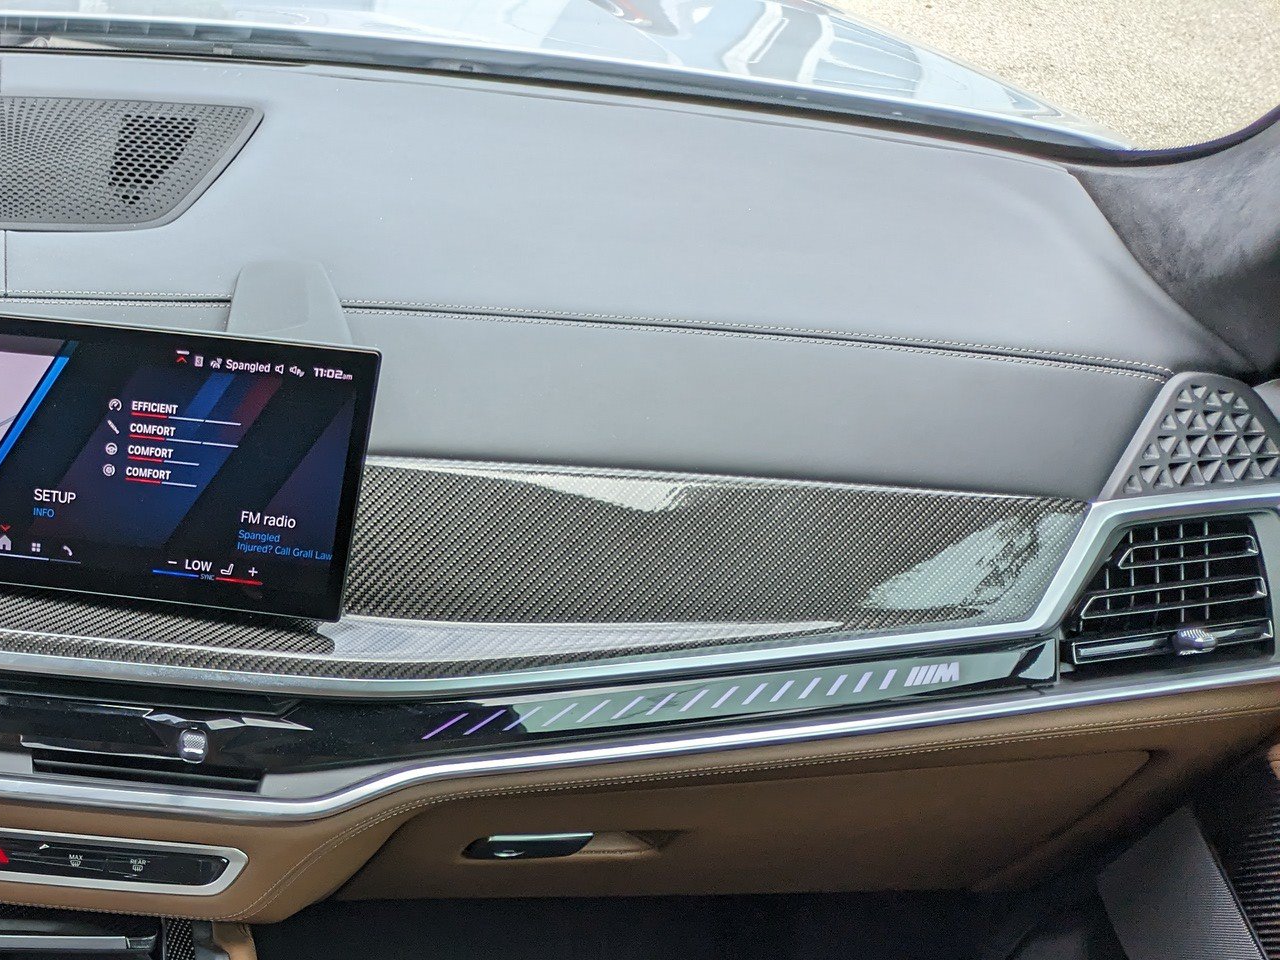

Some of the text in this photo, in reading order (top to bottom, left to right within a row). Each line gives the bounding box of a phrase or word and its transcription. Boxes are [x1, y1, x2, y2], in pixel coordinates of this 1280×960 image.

[225, 358, 271, 374] Spangled
[131, 400, 179, 415] EFFICIENT
[129, 423, 176, 437] COMFORT
[127, 445, 174, 459] COMFORT
[125, 466, 172, 480] COMFORT
[33, 488, 77, 504] SETUP
[33, 507, 55, 518] INFO
[240, 510, 297, 529] FM radio
[238, 529, 281, 542] Spangled
[236, 541, 334, 561] Injured? Call Grall Law
[185, 559, 213, 572] LOW
[200, 573, 215, 582] SYNC
[130, 858, 147, 866] REAR
